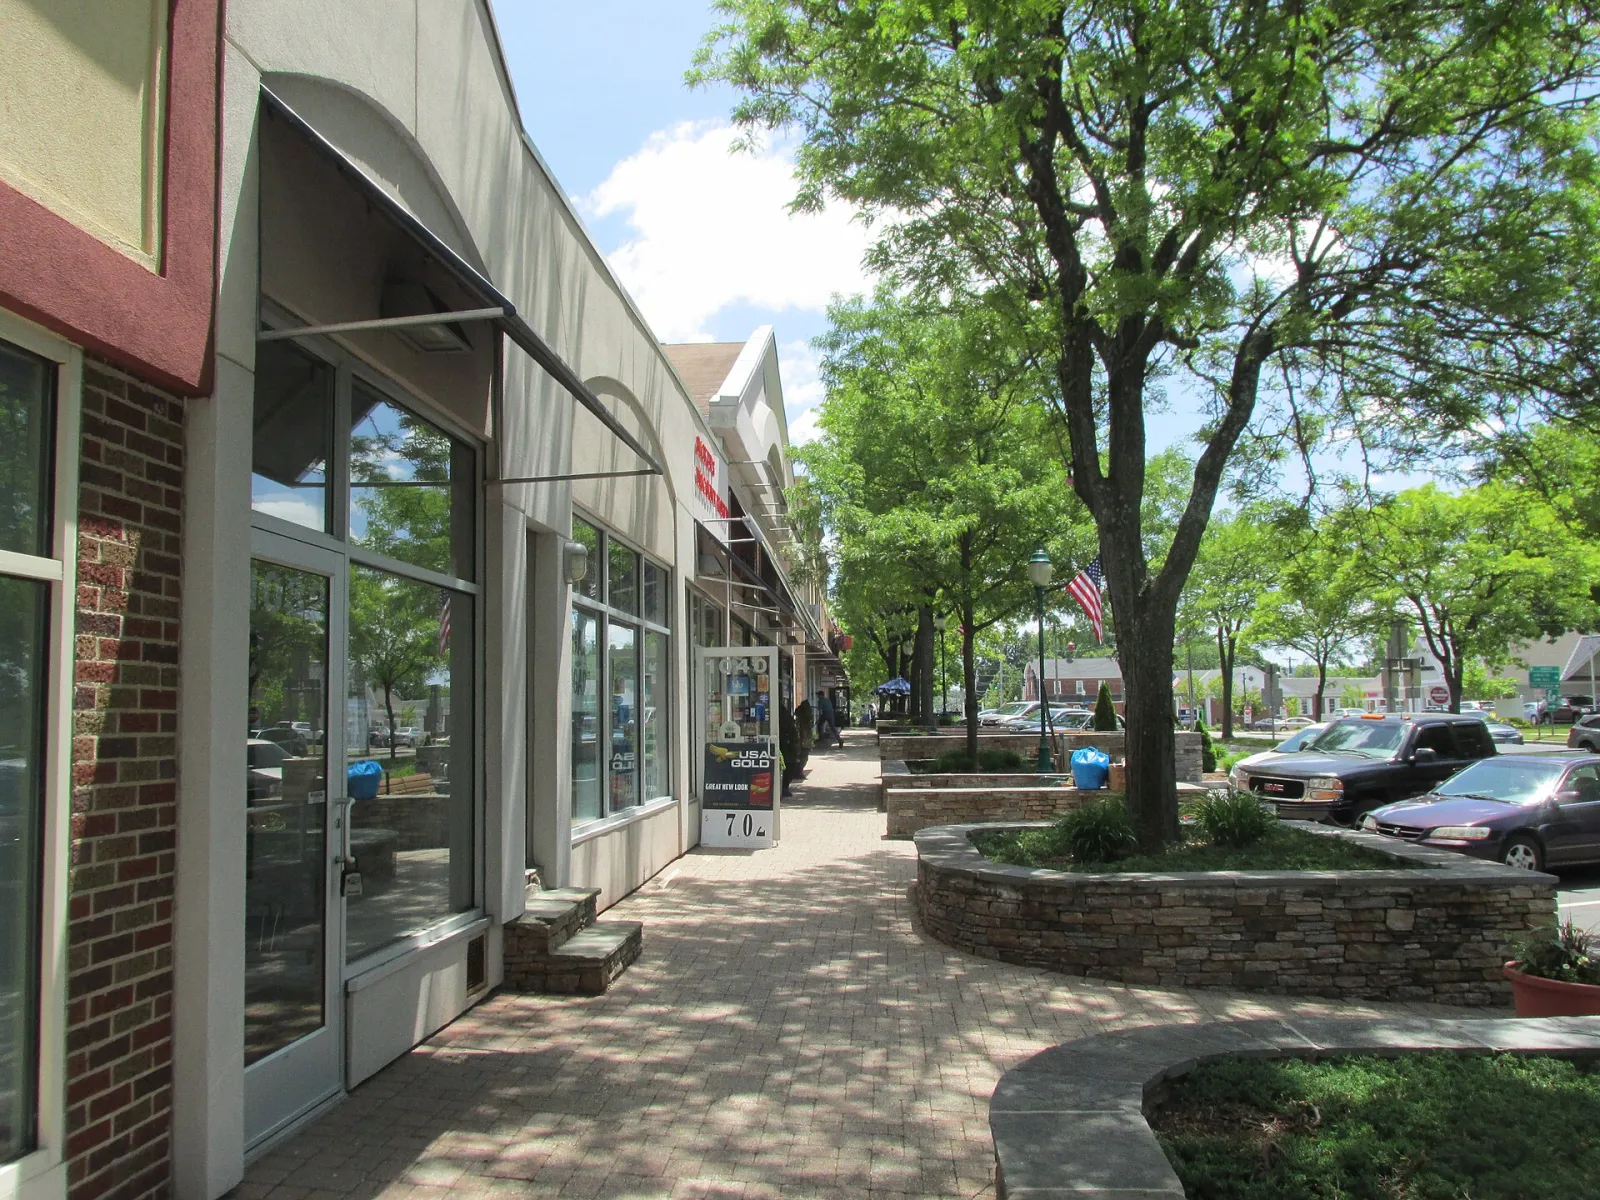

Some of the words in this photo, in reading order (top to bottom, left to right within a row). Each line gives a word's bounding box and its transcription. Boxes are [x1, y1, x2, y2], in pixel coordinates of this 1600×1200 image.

[706, 658, 768, 674] 1040
[739, 750, 769, 759] USA
[731, 759, 770, 768] GOLD
[722, 783, 734, 791] NEW
[734, 783, 749, 791] LOOK
